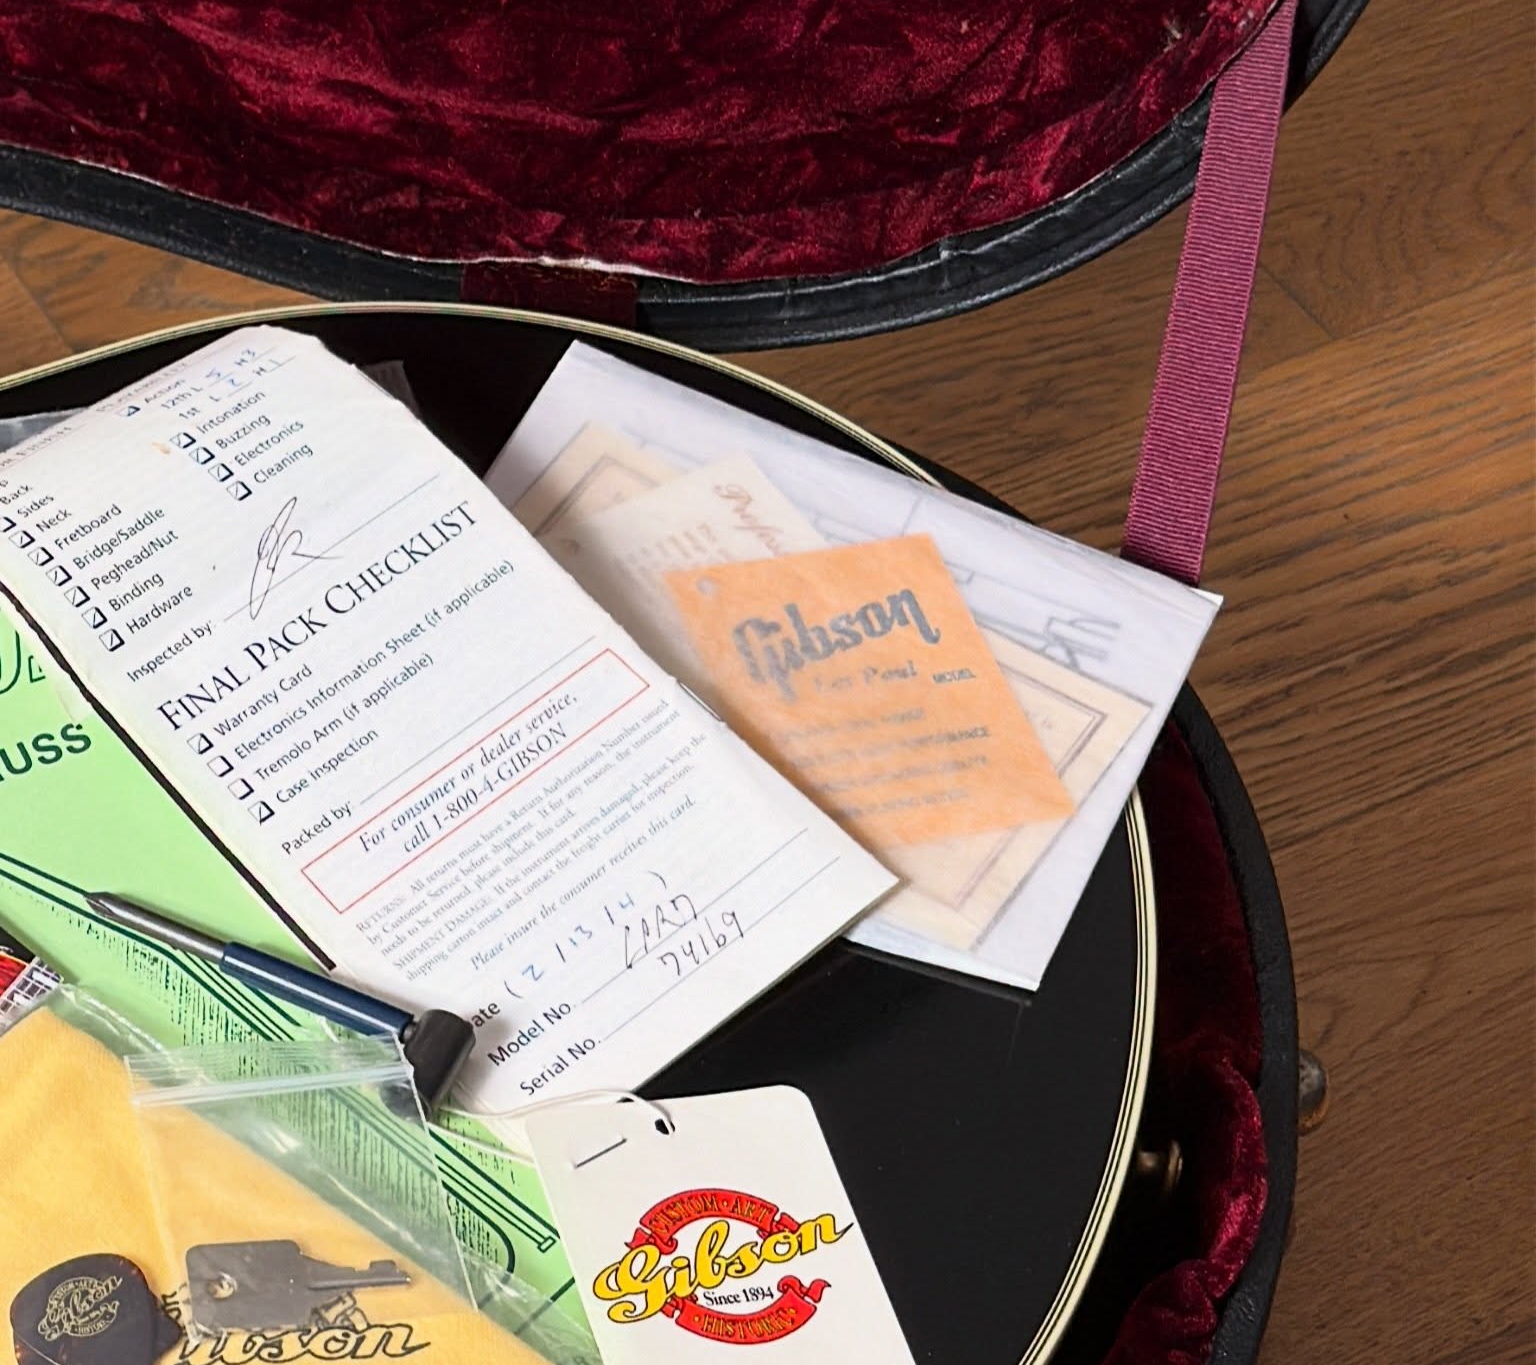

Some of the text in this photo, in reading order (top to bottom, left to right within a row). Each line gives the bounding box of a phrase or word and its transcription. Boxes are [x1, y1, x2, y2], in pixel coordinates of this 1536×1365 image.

[179, 407, 201, 420] 1st
[198, 390, 266, 435] Intonation
[215, 414, 271, 450] Buzzing
[234, 421, 304, 467] Electronics
[253, 443, 314, 485] Cleaning
[0, 484, 33, 506] Back
[17, 494, 54, 519] Sides
[36, 508, 73, 533] Neck
[54, 503, 122, 551] Fretboard
[72, 506, 166, 571] Bridge/Saddle
[90, 529, 179, 592] Peghead/Nut
[108, 572, 165, 612] Binding
[125, 585, 194, 634] Hardware
[156, 660, 251, 731] FINAL
[243, 607, 328, 672] PACK
[324, 500, 478, 617] CHECKLIST
[126, 632, 193, 683] Inspected
[233, 559, 516, 760] Electronics Information Sheet (if applicable)
[731, 587, 941, 705] Gibson
[213, 663, 314, 737] Warranty Card
[255, 652, 435, 783] Tremolo Arm (if applicable)
[600, 719, 641, 751] Number
[275, 727, 379, 805] Case inspection
[358, 692, 579, 853] For consumer or dealer service,
[404, 721, 568, 853] call 1-800-4-GIBSON
[281, 815, 329, 856] Packed
[459, 852, 490, 880] before
[470, 936, 505, 971] Please
[503, 915, 540, 945] insure
[558, 866, 608, 909] consumer
[608, 835, 649, 867] receives
[668, 793, 697, 821] card.
[468, 1002, 501, 1030] ate
[488, 1019, 546, 1067] Model
[520, 1037, 602, 1096] Serial No.
[648, 1194, 773, 1236] CUSTOM ART
[593, 1213, 855, 1324] Gibson
[37, 1275, 123, 1341] Gibson
[703, 1282, 775, 1306] Since 1894
[700, 1306, 790, 1340] HISTORIC
